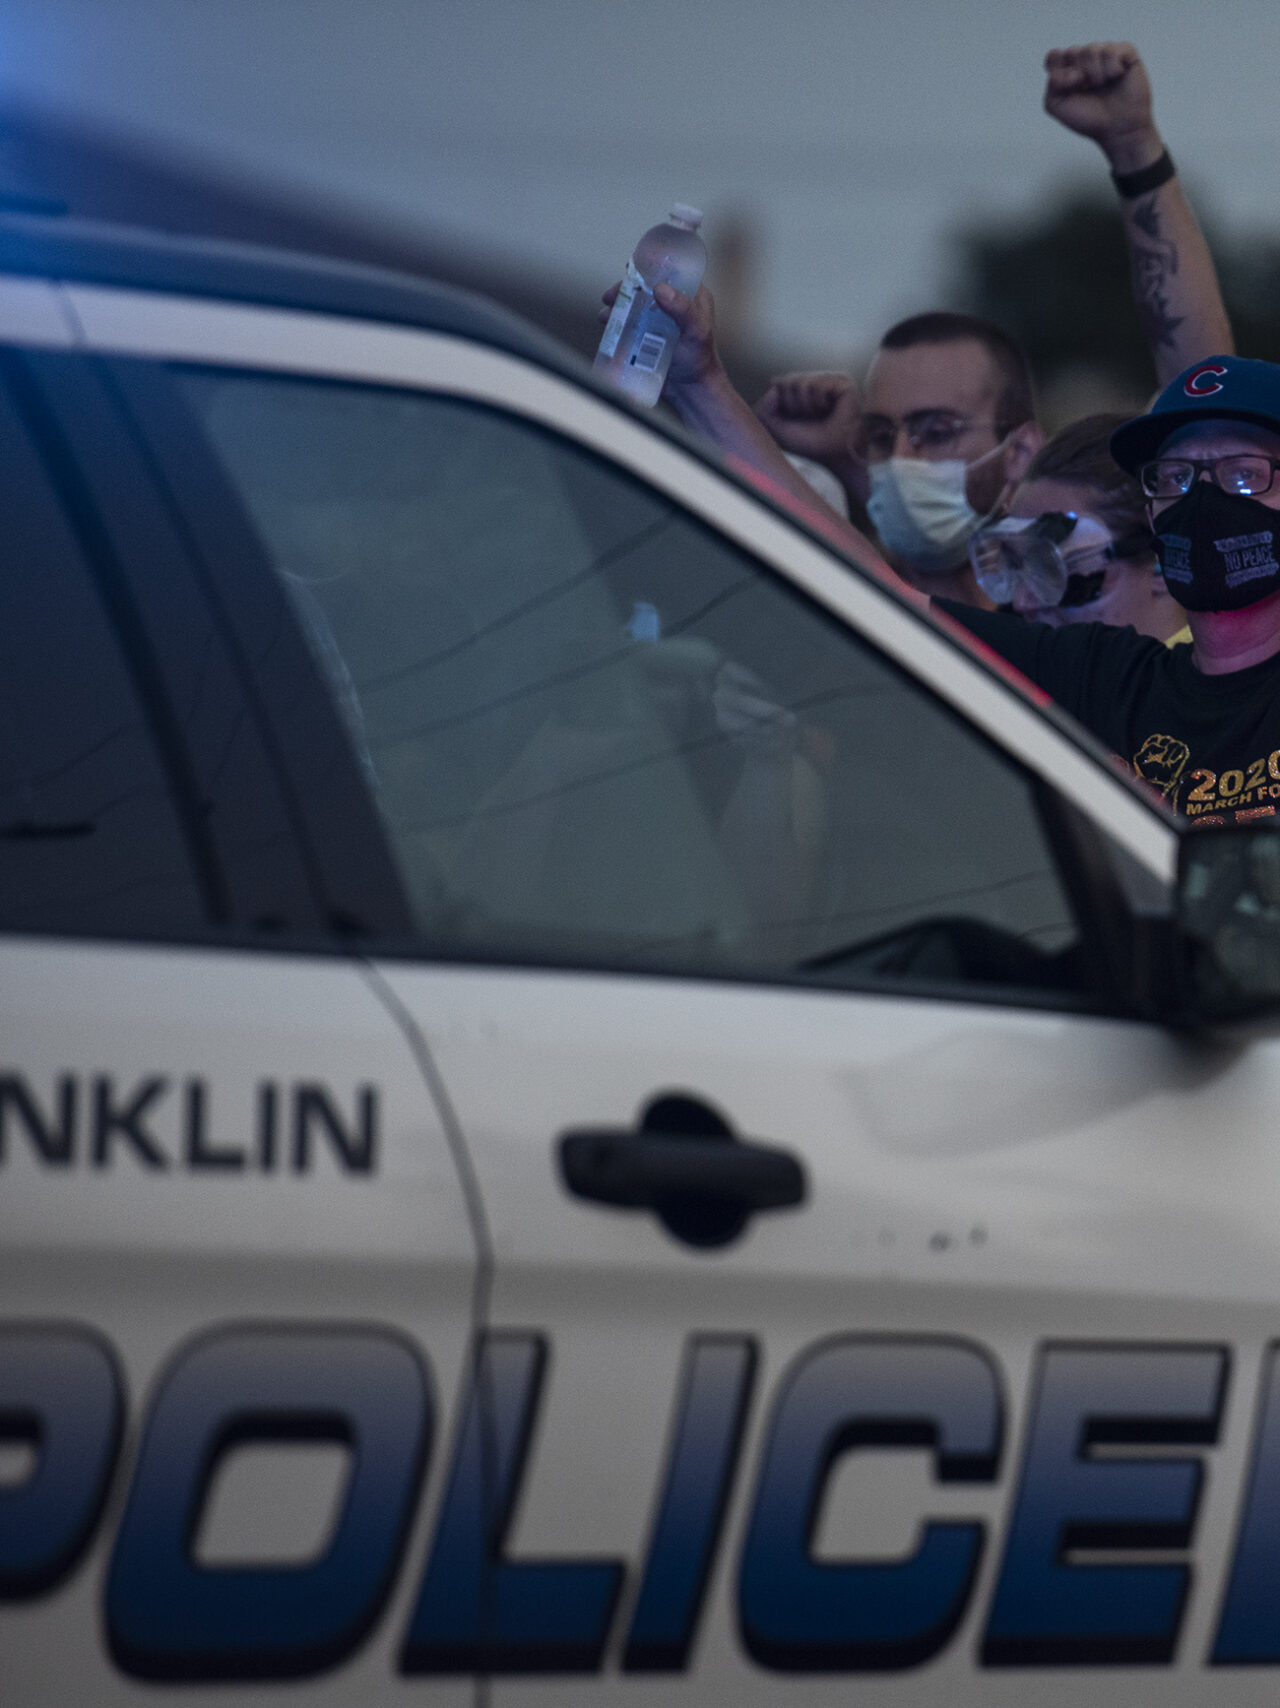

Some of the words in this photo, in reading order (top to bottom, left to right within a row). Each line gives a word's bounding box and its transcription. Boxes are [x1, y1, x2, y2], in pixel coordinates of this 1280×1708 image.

[1184, 364, 1228, 397] C
[1224, 551, 1241, 573] NO
[1242, 543, 1275, 568] PEACE
[1186, 791, 1252, 815] MARCH
